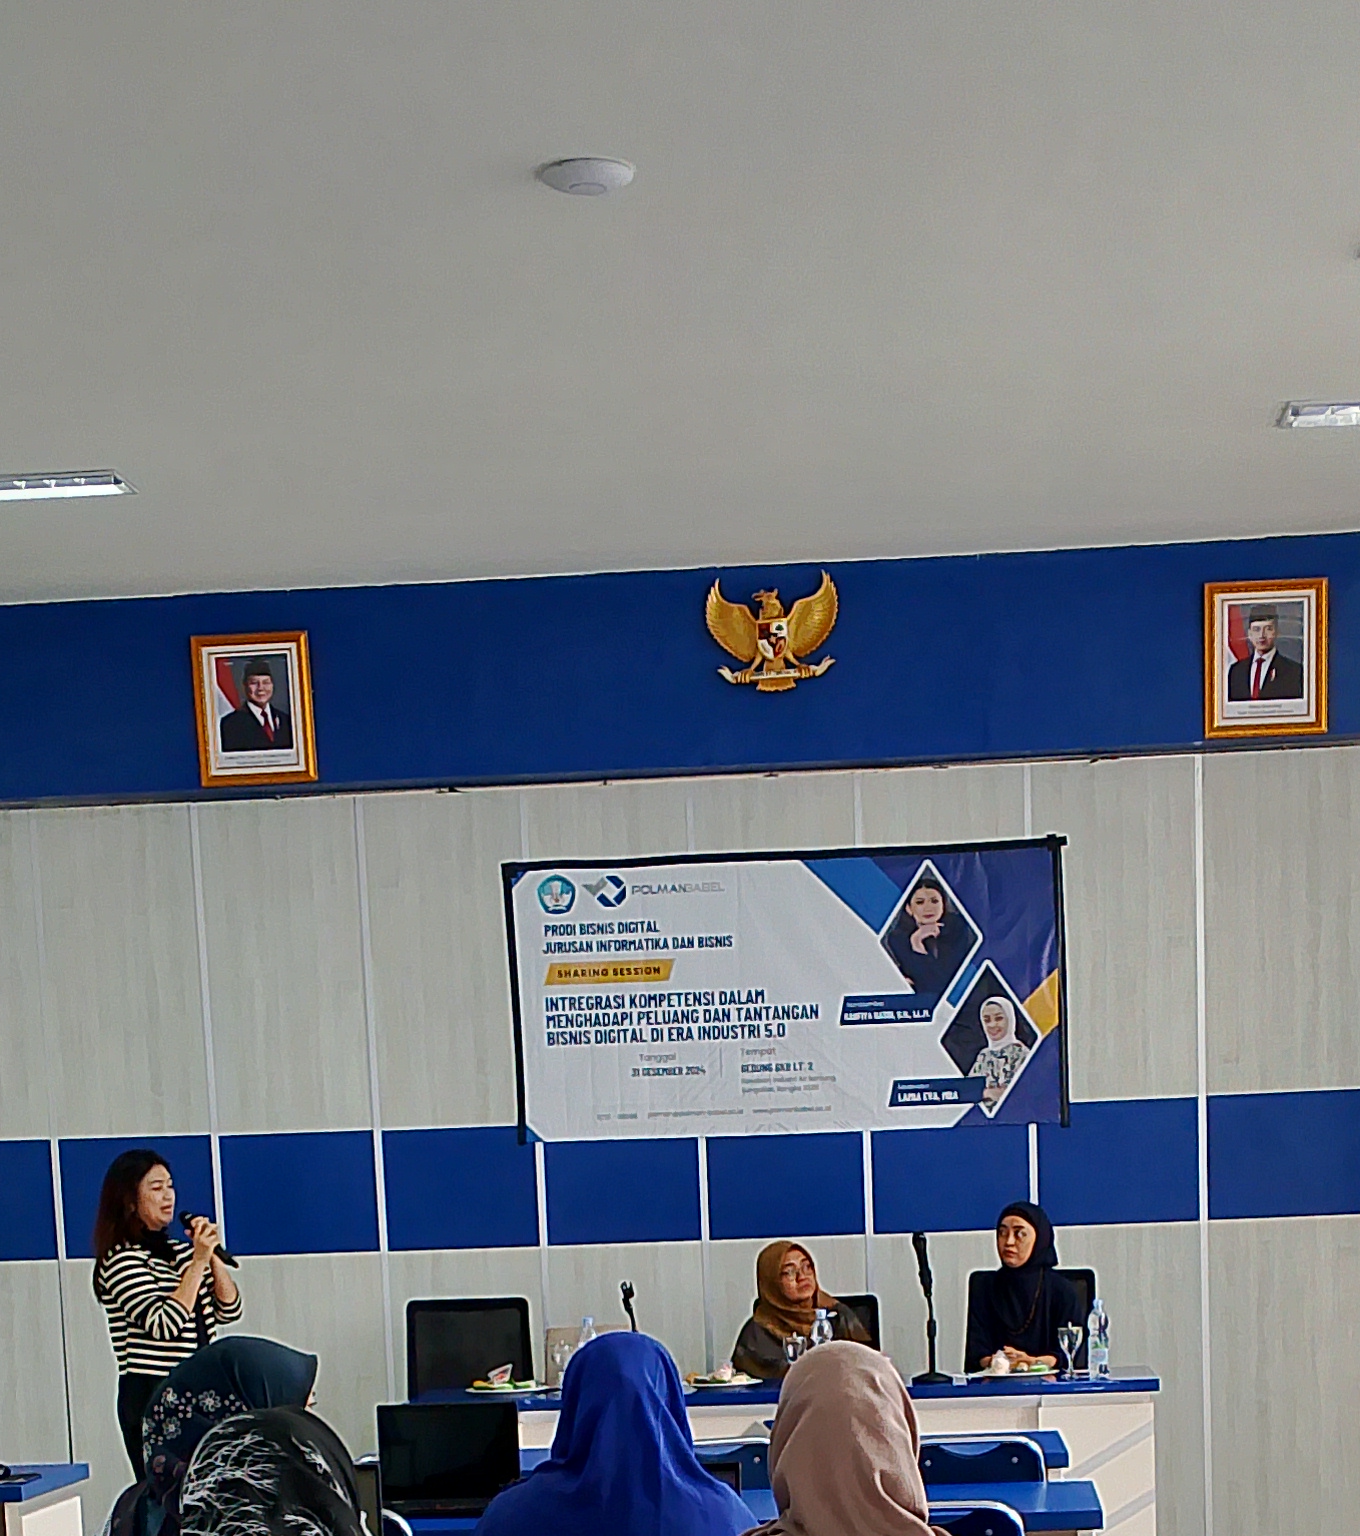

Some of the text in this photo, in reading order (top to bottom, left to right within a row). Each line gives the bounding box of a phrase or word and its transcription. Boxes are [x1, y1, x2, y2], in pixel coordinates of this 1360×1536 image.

[544, 920, 660, 937] PRODI BISNIS DIGITAL
[543, 935, 733, 954] JURUSAN INFORMATIKA DAN BISNIS
[557, 966, 661, 979] SHARING SESSION
[545, 989, 765, 1012] INTREGRASI KOMPETENSI DALAM
[546, 1004, 819, 1029] MENGHADAPI PELUANG DAN TANTANGAN
[547, 1022, 786, 1046] BISNIS DIGITAL DI ERA INDUSTRI 5.0
[639, 1052, 676, 1063] Tanggal
[741, 1047, 776, 1057] Tempat
